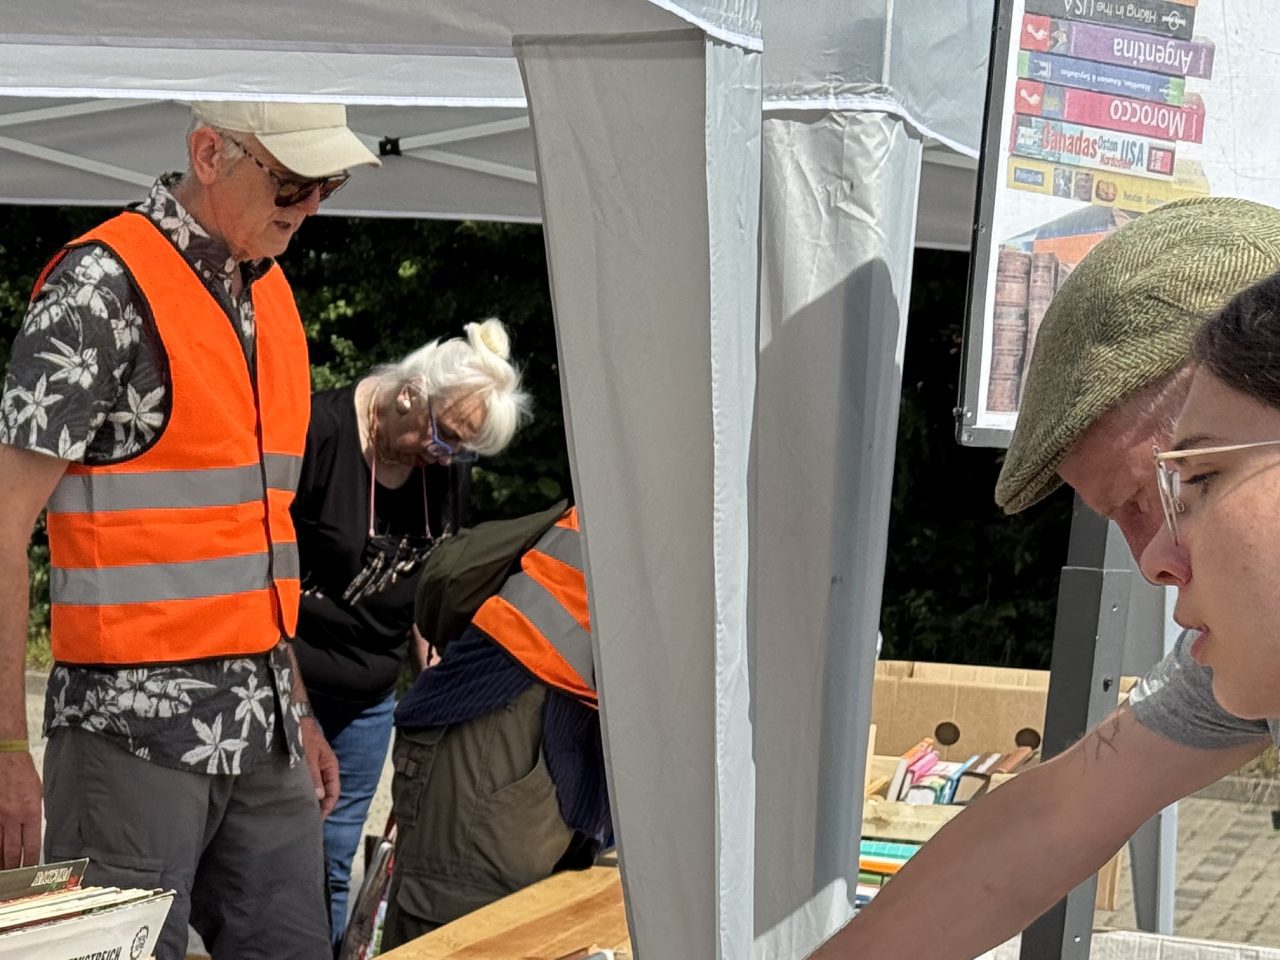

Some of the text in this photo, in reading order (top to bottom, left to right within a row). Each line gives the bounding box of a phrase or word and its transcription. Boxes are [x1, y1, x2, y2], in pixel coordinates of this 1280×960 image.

[1096, 3, 1112, 13] the
[1126, 7, 1157, 23] Hiking
[1113, 38, 1193, 73] Argentina
[1110, 100, 1186, 138] Morocco
[1120, 139, 1144, 167] USA
